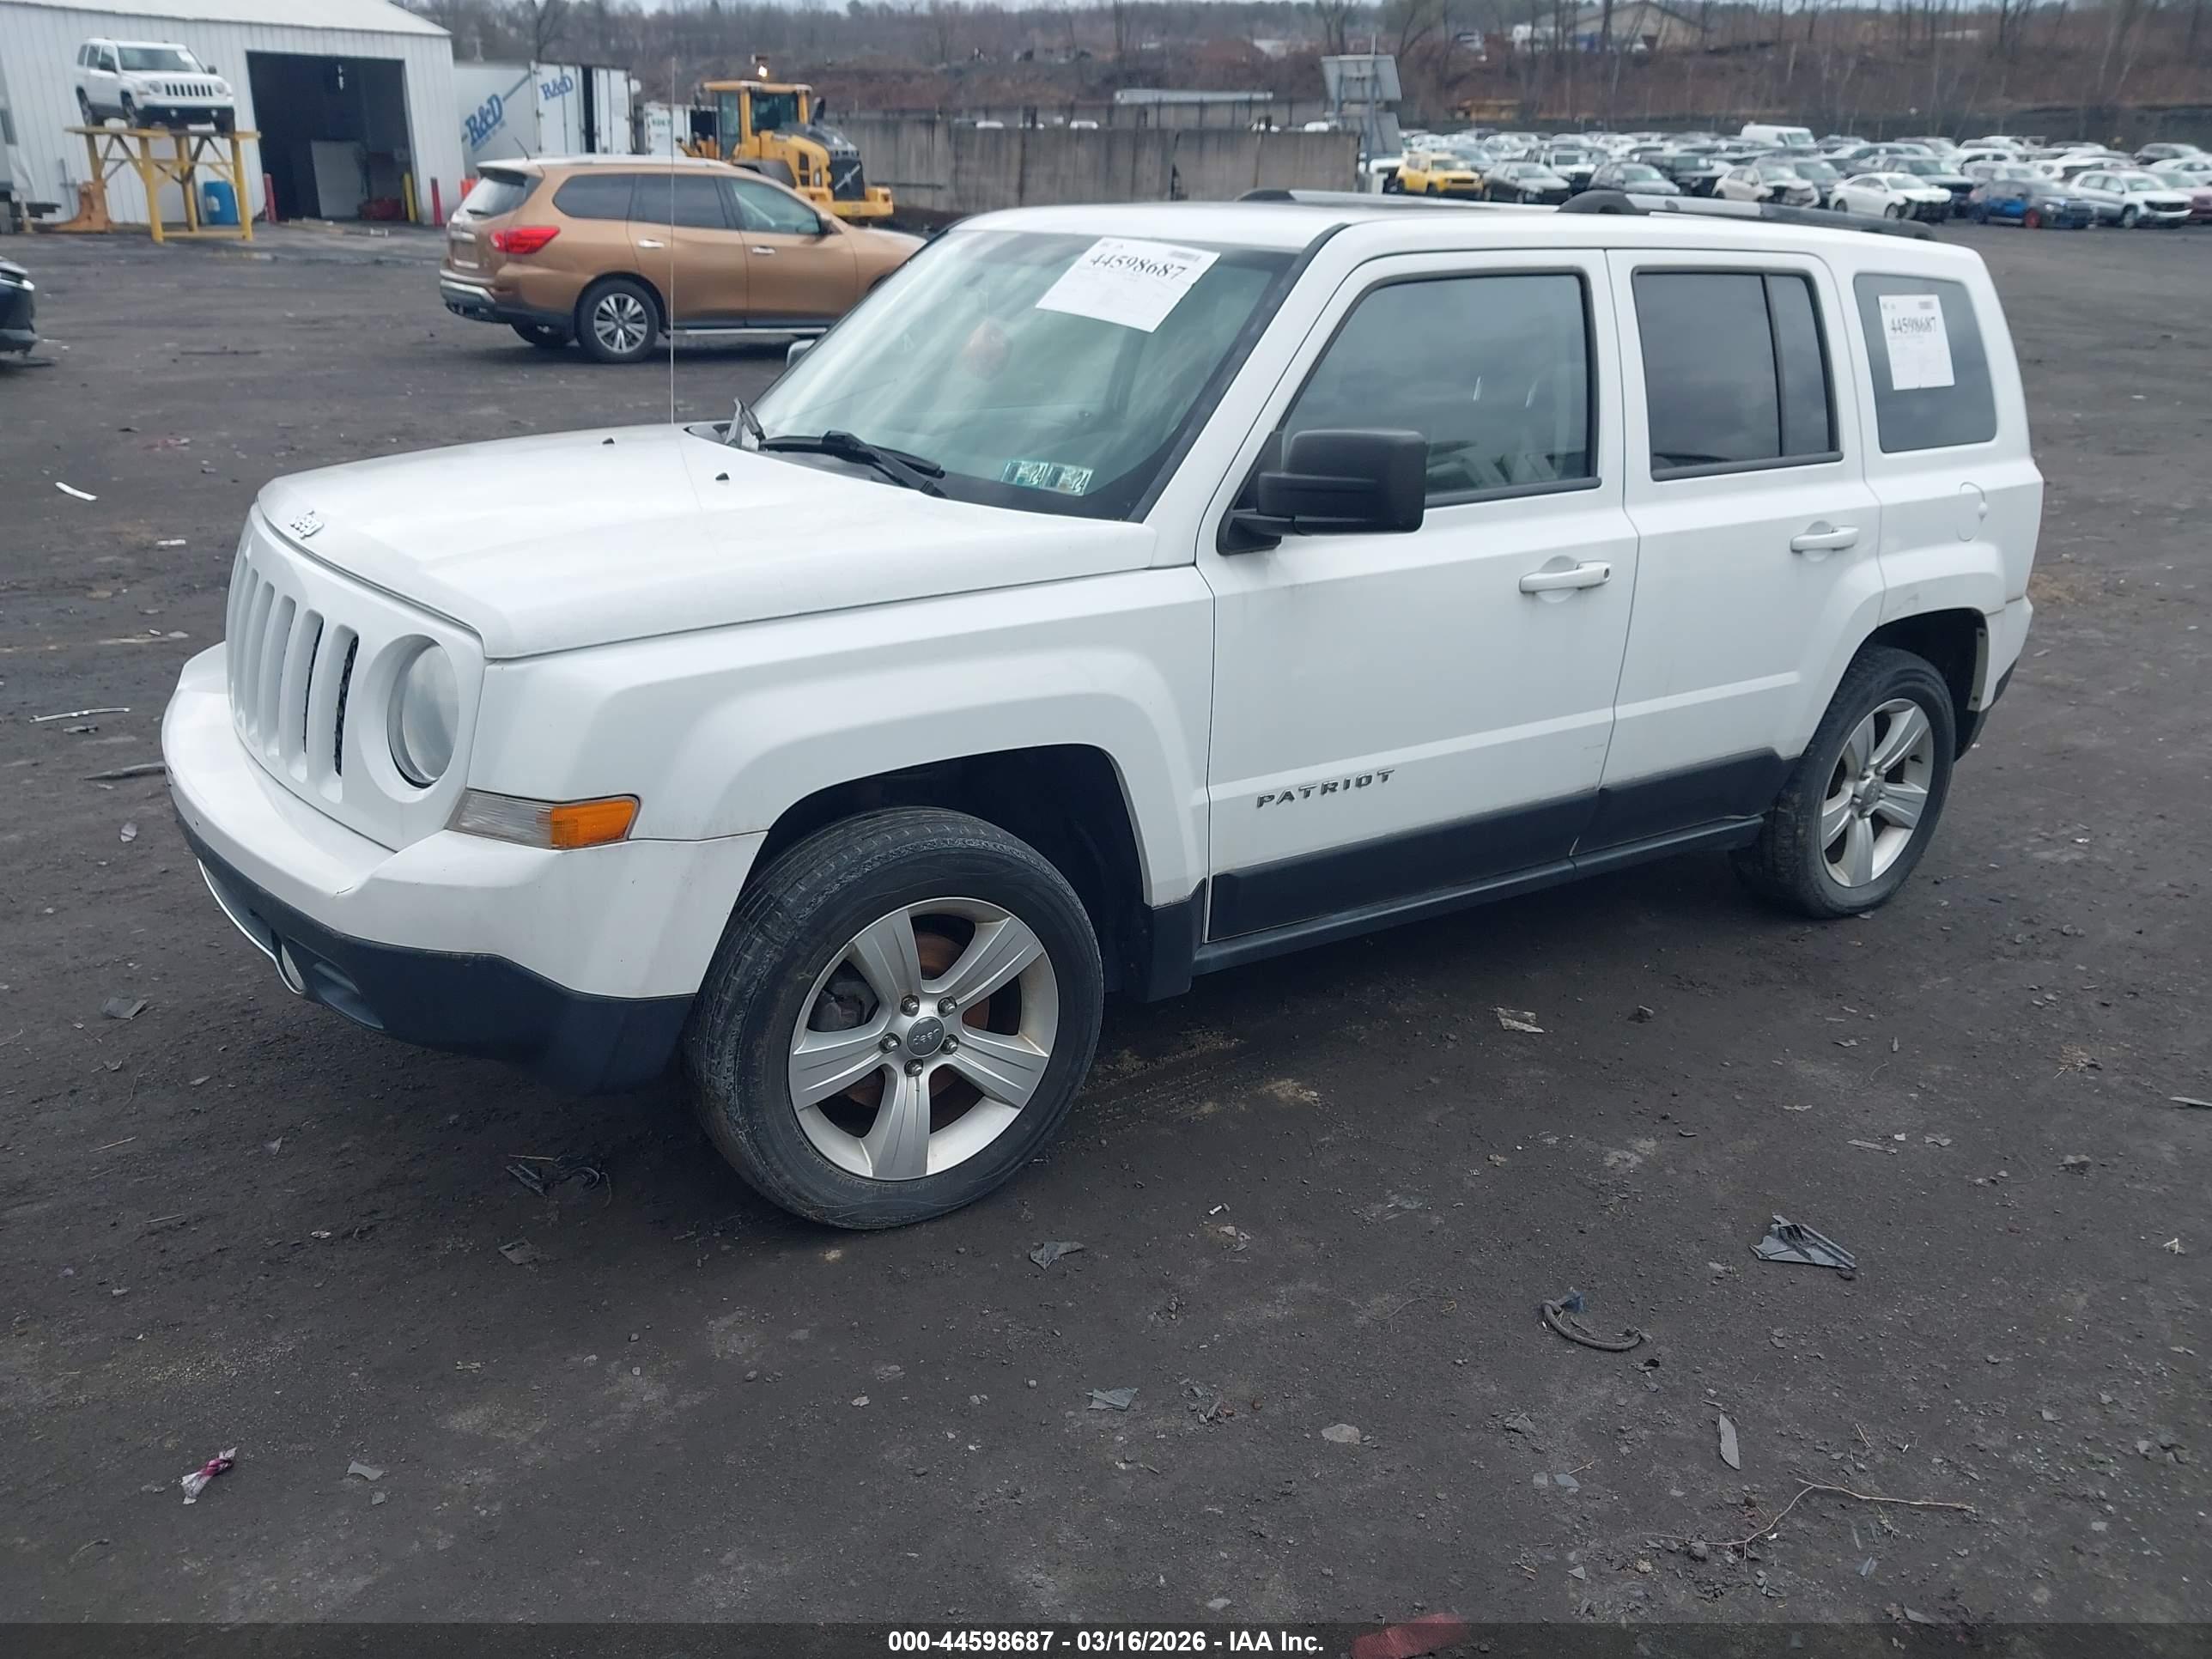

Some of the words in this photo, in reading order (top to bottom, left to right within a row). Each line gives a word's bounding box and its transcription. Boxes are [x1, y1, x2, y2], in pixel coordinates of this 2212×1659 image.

[540, 75, 574, 100] R&D
[465, 93, 503, 147] R&D
[1090, 252, 1188, 280] 44598687
[1891, 316, 1937, 334] 44598687
[1256, 769, 1395, 809] PATRIOT
